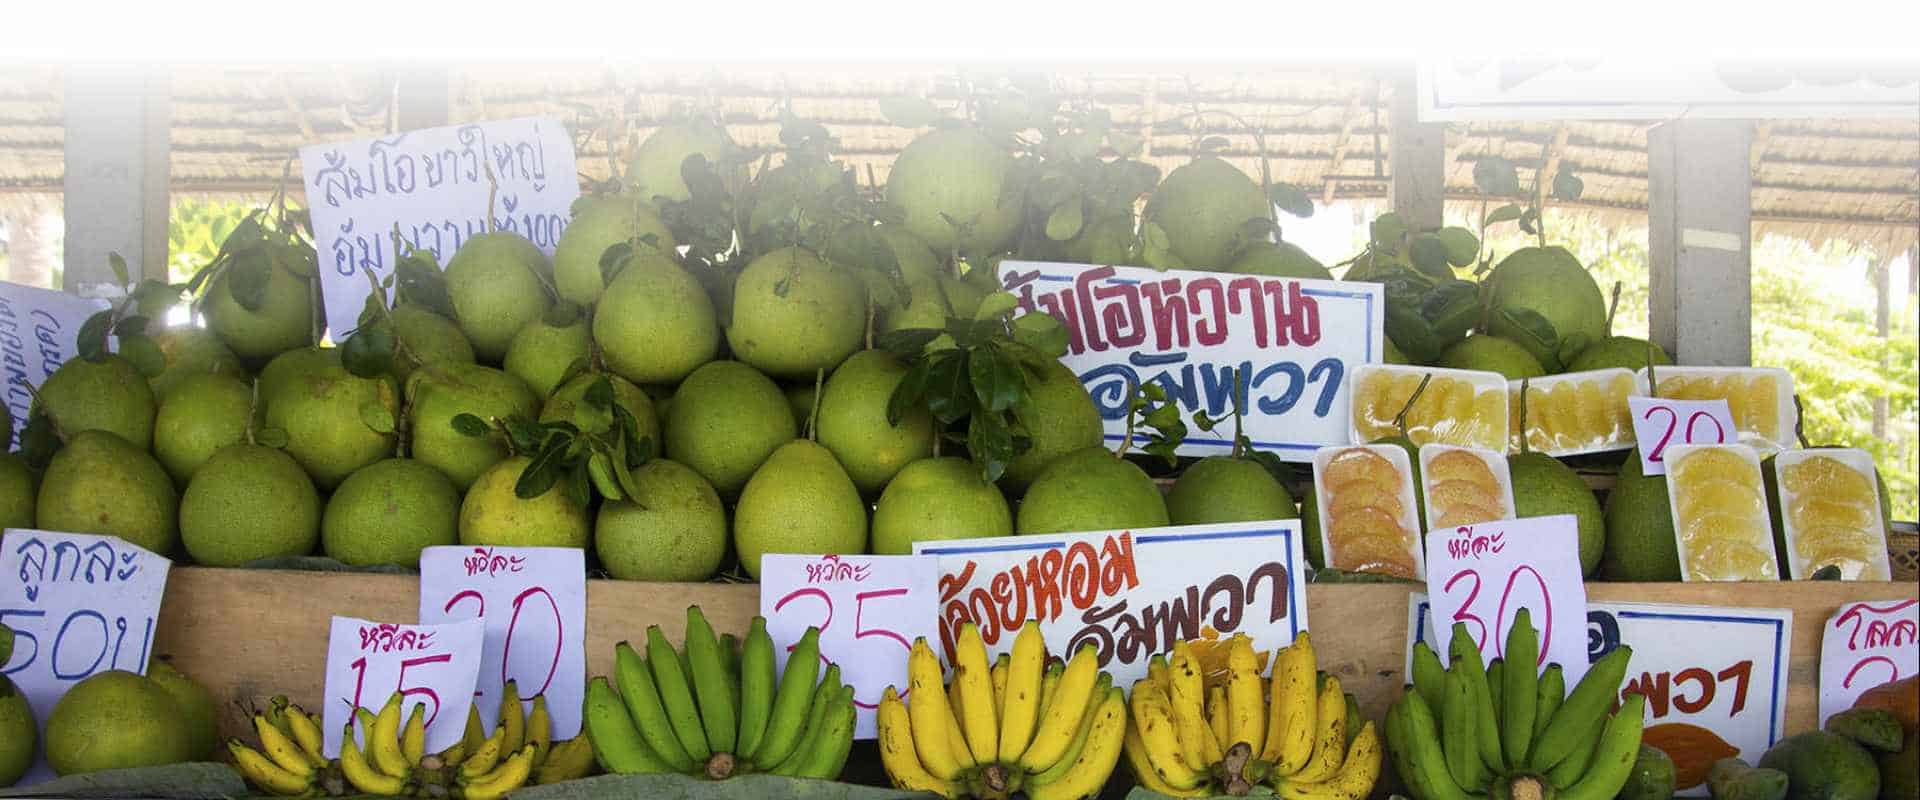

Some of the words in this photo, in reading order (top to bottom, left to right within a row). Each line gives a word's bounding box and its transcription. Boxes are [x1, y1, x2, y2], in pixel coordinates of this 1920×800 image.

[1079, 351, 1345, 420] อัมพวา
[1644, 405, 1725, 462] 20
[16, 537, 138, 602] ลูกละ
[463, 546, 529, 578] หวีละ
[806, 554, 872, 584] หวีละ
[1447, 526, 1505, 560] หวีละ
[359, 624, 437, 653] หวีละ
[1065, 562, 1289, 670] อัมพวา
[1443, 564, 1552, 667] 30
[1836, 599, 1919, 650] โลล
[351, 654, 451, 730] 15
